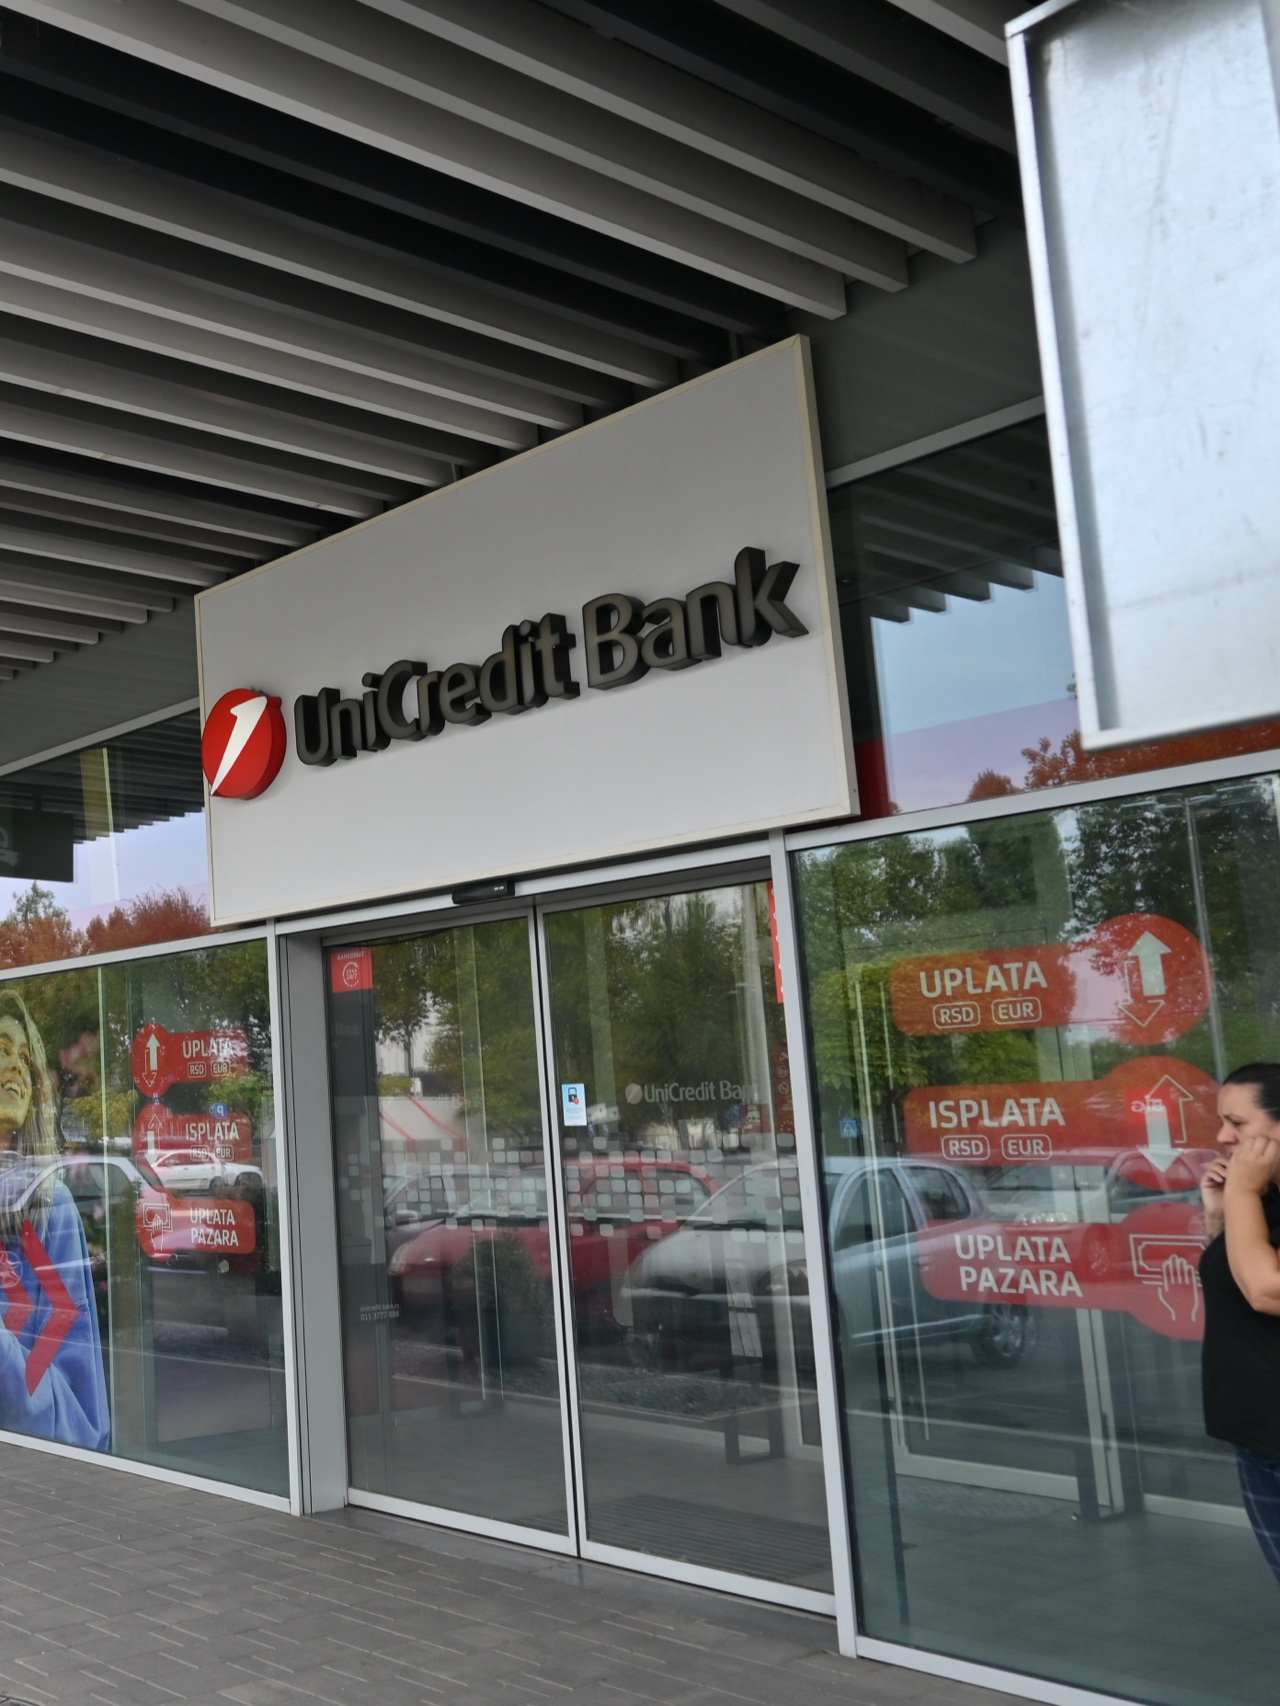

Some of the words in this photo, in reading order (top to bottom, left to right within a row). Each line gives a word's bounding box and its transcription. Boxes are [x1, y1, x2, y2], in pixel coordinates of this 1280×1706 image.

[294, 612, 581, 768] UniCredit
[581, 546, 810, 690] Bank
[919, 960, 1049, 999] UPLATA
[939, 1006, 975, 1024] RSD
[997, 1001, 1036, 1020] EUR
[182, 1036, 234, 1059] UPLATA
[189, 1065, 204, 1075] RSD
[212, 1062, 228, 1074] EUR
[643, 1080, 717, 1103] UniCredit
[928, 1097, 1066, 1129] ISPLATA
[185, 1122, 240, 1141] ISPLATA
[192, 1147, 207, 1158] RSD
[215, 1147, 231, 1158] EUR
[948, 1140, 984, 1157] RSD
[1007, 1139, 1046, 1156] EUR
[189, 1207, 236, 1226] UPLATA
[190, 1227, 239, 1247] PAZARA
[954, 1233, 1072, 1264] UPLATA
[959, 1265, 1084, 1298] PAZARA
